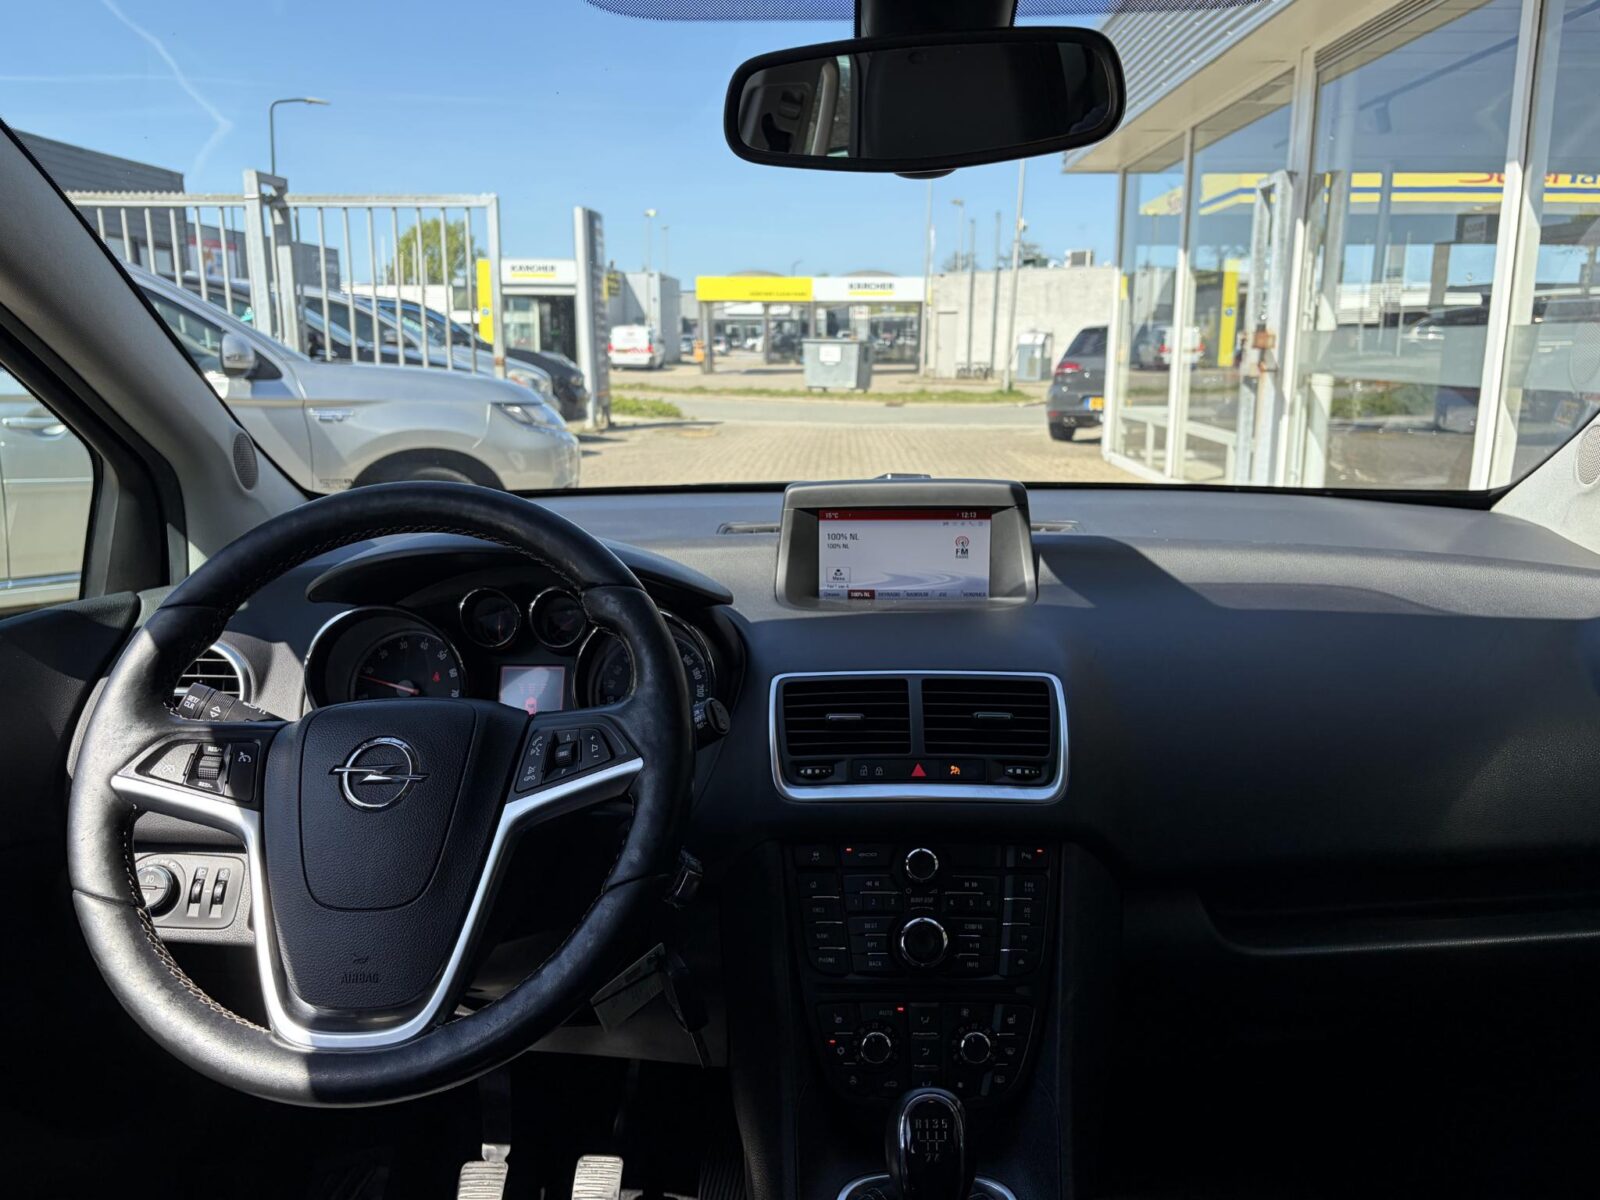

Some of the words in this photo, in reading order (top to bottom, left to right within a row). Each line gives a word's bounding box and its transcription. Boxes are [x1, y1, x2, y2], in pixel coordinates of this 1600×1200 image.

[827, 532, 847, 540] 100%
[849, 532, 859, 540] NL
[399, 640, 409, 650] 30
[420, 641, 429, 651] 40
[696, 684, 705, 698] 200
